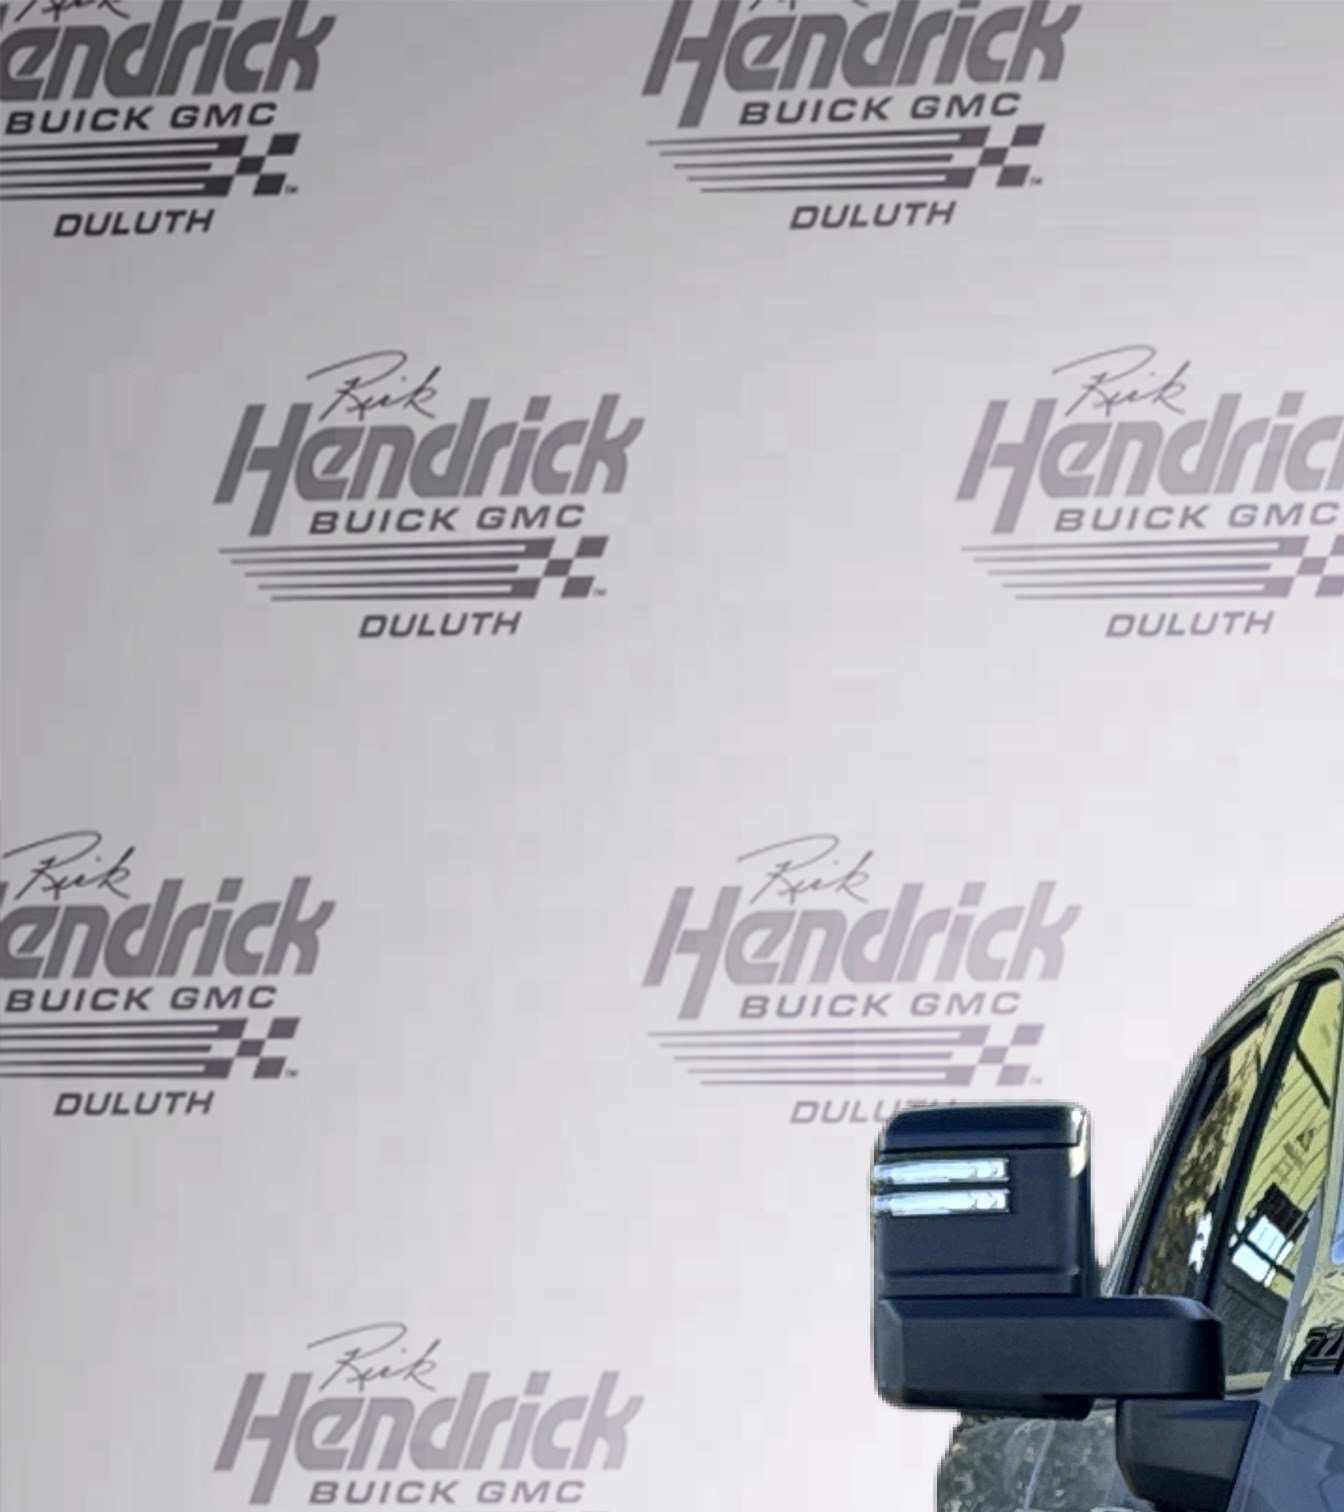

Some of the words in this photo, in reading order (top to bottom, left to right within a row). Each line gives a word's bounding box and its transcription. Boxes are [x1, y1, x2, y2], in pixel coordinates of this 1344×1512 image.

[0, 0, 337, 101] endrick
[641, 0, 1082, 128] Hendrick
[4, 105, 154, 135] BUICK
[169, 102, 278, 130] GMC
[739, 96, 894, 126] BUICK
[909, 93, 1022, 120] GMC
[53, 208, 215, 238] DULUTH
[789, 201, 957, 230] DULUTH
[213, 393, 645, 537] Hendrick
[309, 507, 460, 535] BUICK
[476, 504, 586, 530] GMC
[1053, 504, 1210, 533] BUICK
[1227, 501, 1341, 528] GMC
[358, 611, 522, 639] DULUTH
[1105, 610, 1275, 639] DULUTH
[0, 875, 337, 980] endrick
[641, 880, 1082, 1020] Hendrick
[4, 986, 154, 1013] BUICK
[169, 985, 278, 1011] GMC
[738, 993, 892, 1020] BUICK
[910, 991, 1021, 1017] GMC
[53, 1091, 215, 1117] DULUTH
[213, 1370, 645, 1505] Hendrick
[309, 1481, 460, 1505] BUICK
[476, 1480, 586, 1504] GMC
